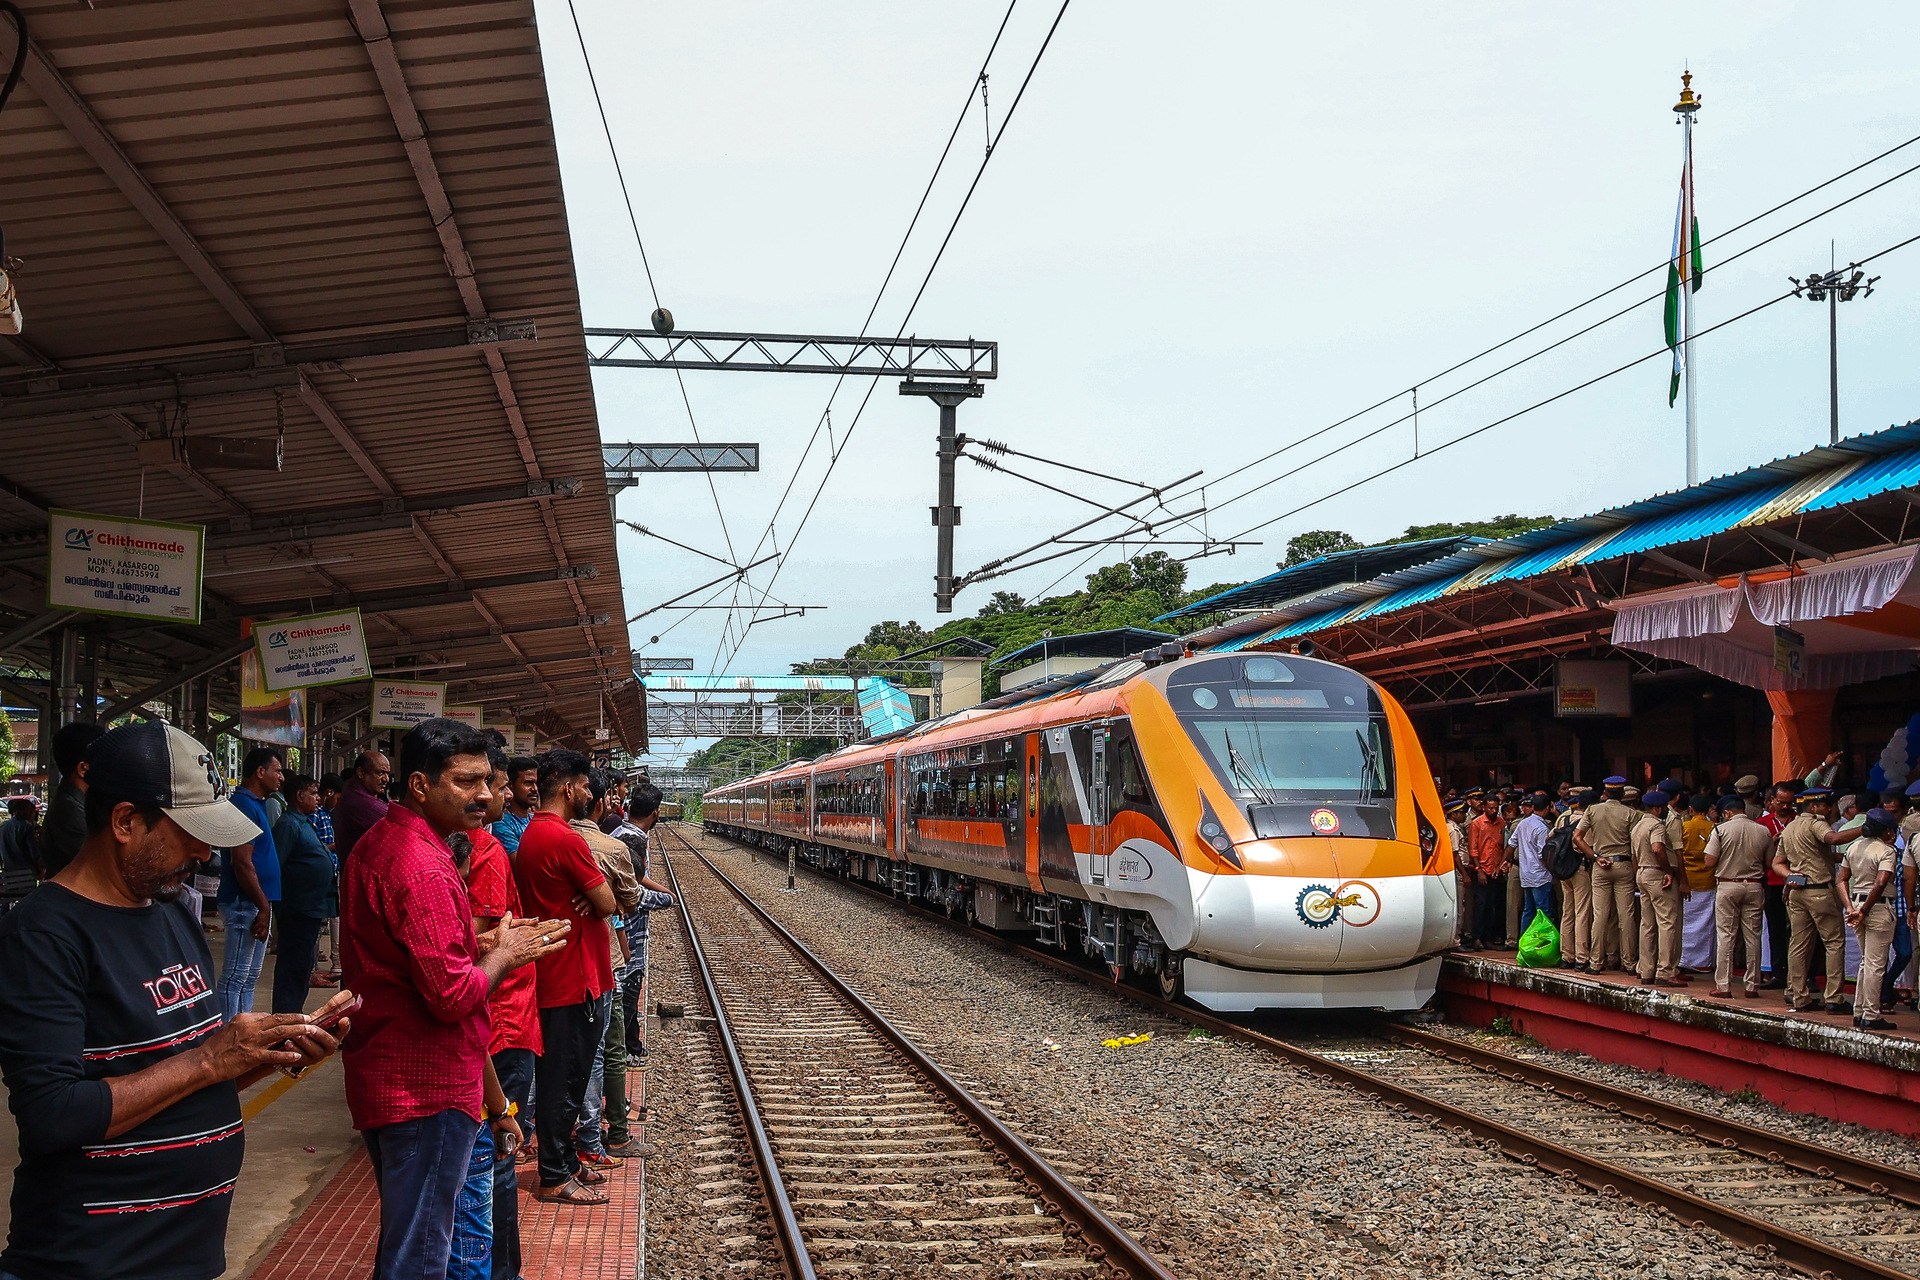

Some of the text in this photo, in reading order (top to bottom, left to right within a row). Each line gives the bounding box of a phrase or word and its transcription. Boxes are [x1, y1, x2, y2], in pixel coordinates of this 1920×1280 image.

[97, 533, 185, 553] Chithamade
[123, 547, 184, 560] Advertisement
[88, 557, 160, 571] PADNE, KASARGOD
[88, 565, 160, 579] MOB: 9446735994
[290, 624, 351, 639] Chithamade
[1788, 650, 1800, 671] 12
[395, 688, 438, 697] Chithamade
